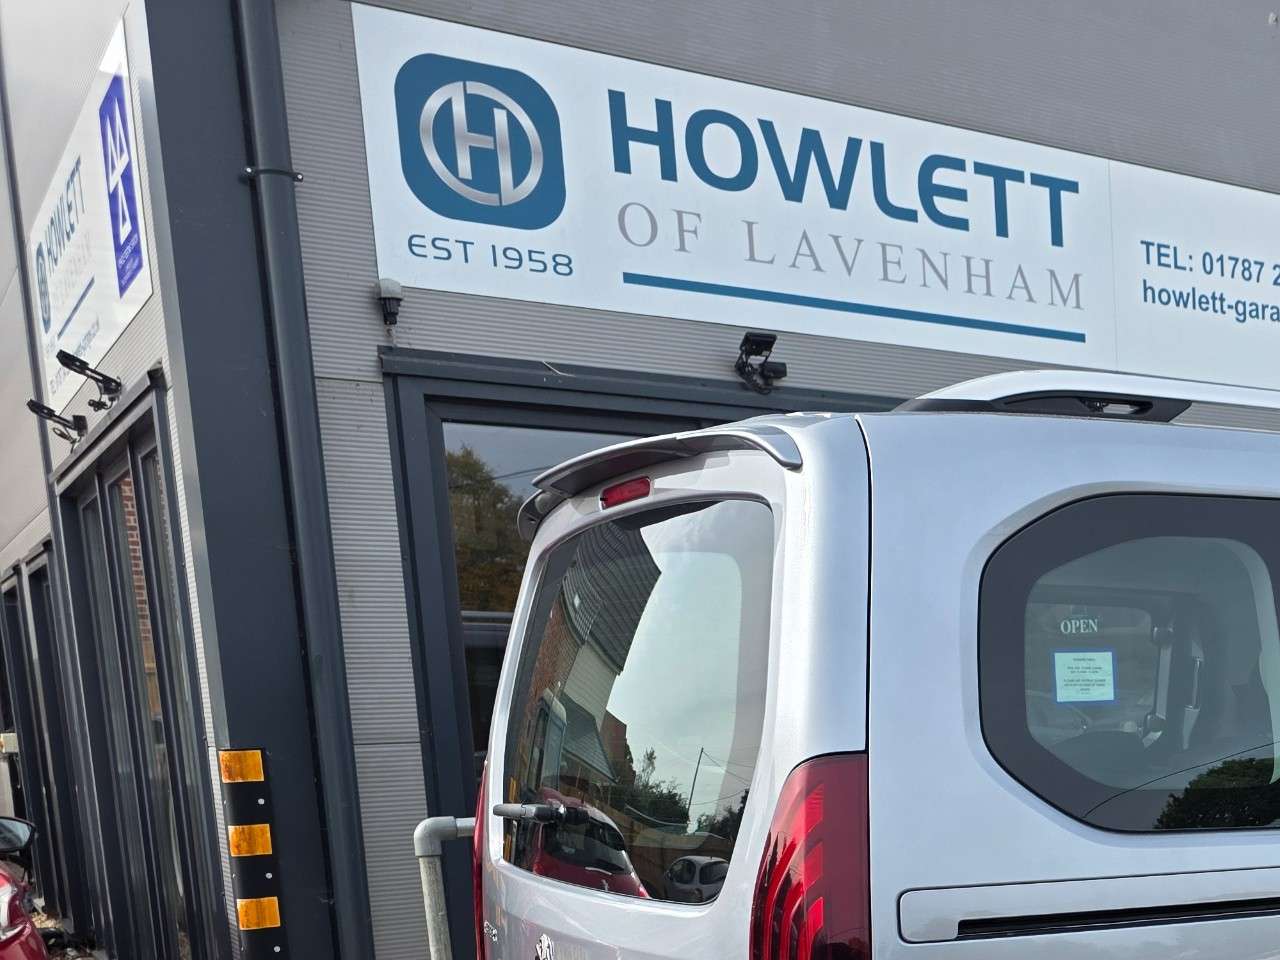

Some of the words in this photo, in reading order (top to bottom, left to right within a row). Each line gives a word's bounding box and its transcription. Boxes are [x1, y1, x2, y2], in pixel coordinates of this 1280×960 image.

[607, 89, 1079, 248] HOWLETT
[407, 234, 475, 265] EST
[492, 244, 574, 277] 1958
[617, 201, 703, 253] OF
[744, 220, 1085, 310] LAVENHAM
[1140, 240, 1194, 273] TEL:
[1202, 252, 1265, 284] 01787
[1060, 618, 1099, 634] OPEN
